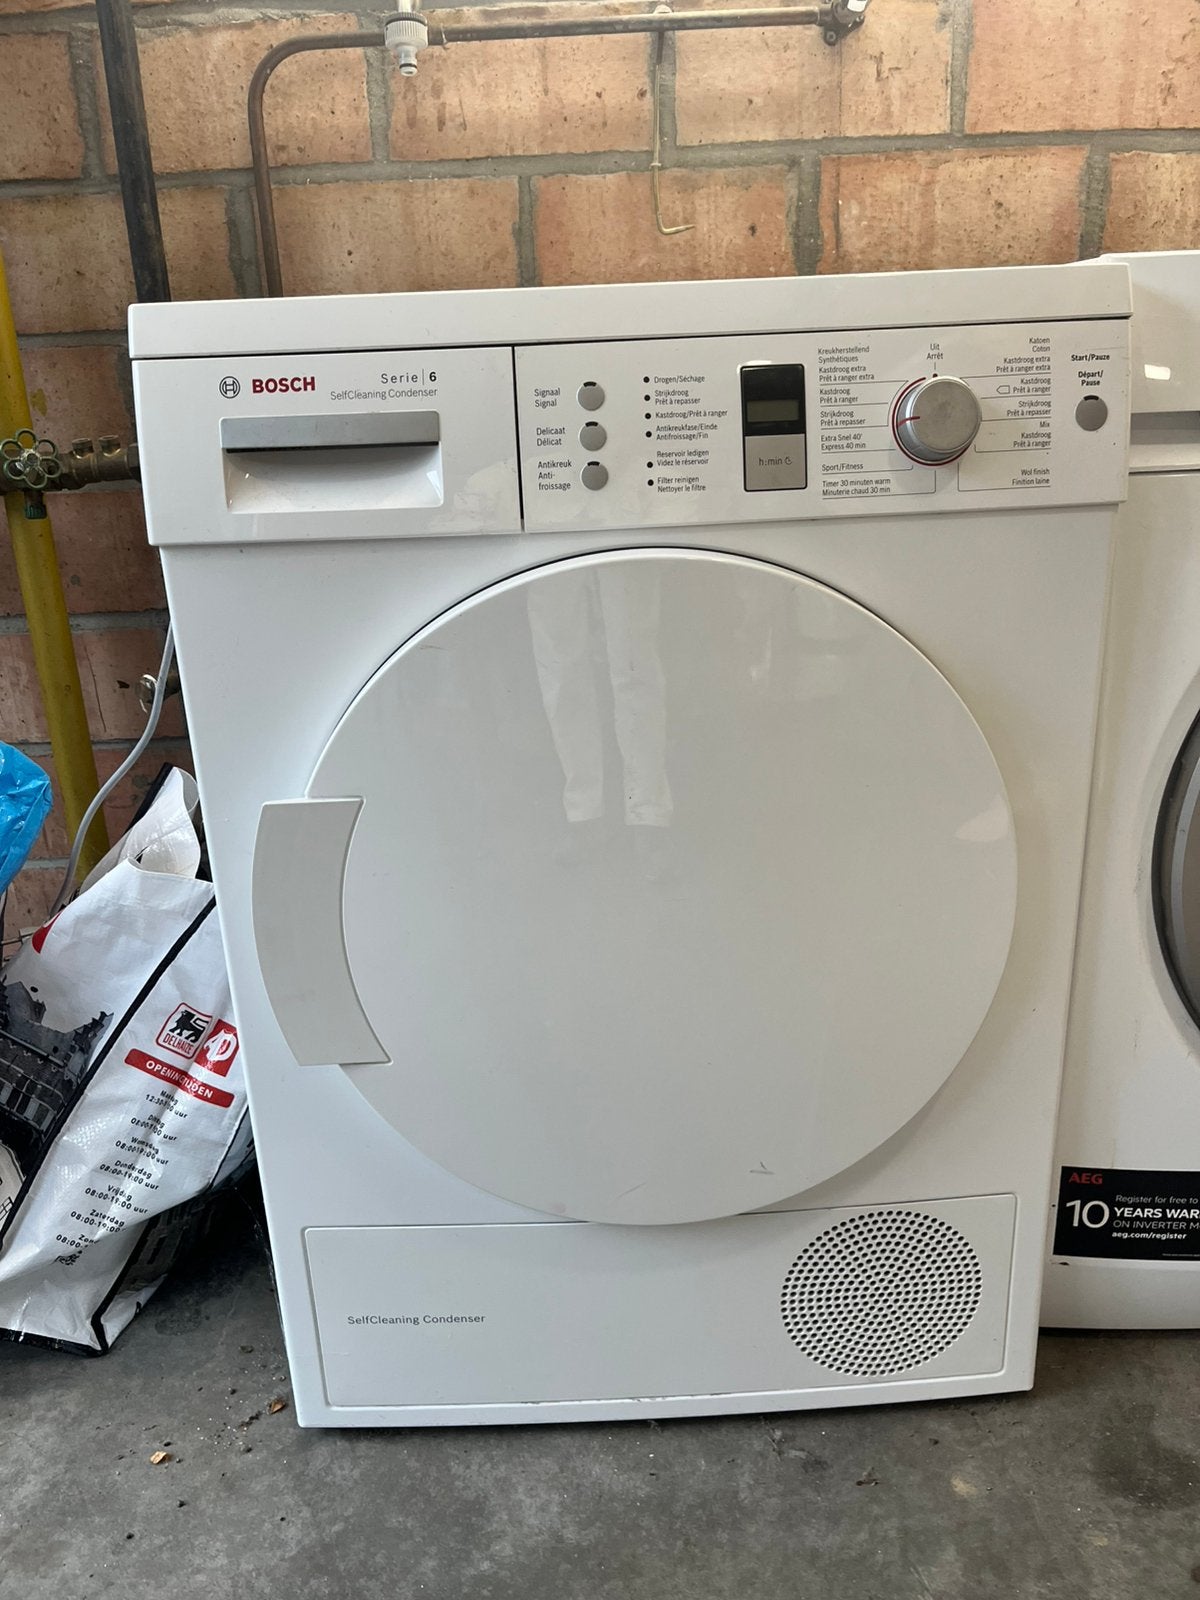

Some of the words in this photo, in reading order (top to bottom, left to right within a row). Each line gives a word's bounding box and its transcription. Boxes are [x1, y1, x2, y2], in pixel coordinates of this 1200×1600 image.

[818, 346, 870, 355] Kreukherstellend
[818, 356, 858, 364] Synthétiques
[927, 352, 943, 360] Arrêt
[1071, 354, 1110, 362] Start/Pauze
[819, 366, 850, 374] Kastdroog
[1078, 370, 1104, 378] Départ/
[381, 373, 418, 384] Serie
[429, 371, 437, 382] 6
[654, 376, 705, 384] Drogen/Séchage
[1020, 377, 1051, 385] Kastdroog
[252, 376, 316, 393] BOSCH
[330, 389, 387, 400] SelfCleaning
[388, 388, 438, 398] Condenser
[534, 388, 560, 398] Signaal
[535, 399, 557, 409] Signal
[1018, 400, 1051, 408] Strijkdroog
[656, 410, 702, 419] Kastdroog/Prêt
[708, 410, 727, 418] ranger
[820, 410, 854, 418] Strijkdroog
[536, 427, 565, 436] Delicaat
[656, 423, 718, 432] Antikreukfase/Einde
[656, 432, 708, 441] Antifroissage/Fin
[1021, 431, 1051, 439] Kastdroog
[537, 438, 562, 446] Délicat
[1032, 440, 1051, 448] ranger
[821, 443, 844, 451] Express
[657, 450, 686, 458] Reservoir
[687, 450, 709, 458] ledigen
[538, 460, 572, 468] Antikreuk
[682, 458, 709, 466] réservoir
[758, 457, 782, 466] h:min
[822, 463, 864, 472] Sport/Fitness
[538, 472, 555, 480] Anti-
[675, 476, 699, 484] reinigen
[539, 482, 571, 491] froissage
[851, 487, 869, 495] chaud
[162, 1033, 194, 1054] DELHAIZE
[163, 1133, 178, 1141] uur
[1069, 1172, 1103, 1184] AEG
[145, 1182, 159, 1190] uur
[85, 1187, 132, 1209] 08:00-19:00
[134, 1206, 148, 1214] uur
[1116, 1195, 1152, 1204] Register
[1155, 1196, 1166, 1204] for
[1169, 1196, 1187, 1204] free
[1066, 1200, 1110, 1228] 10
[1114, 1207, 1162, 1218] YEARS
[1166, 1209, 1200, 1219] WAR
[71, 1211, 121, 1232] 08:00-19:00
[90, 1209, 125, 1227] Zaterdag
[1113, 1220, 1130, 1228] ON
[1133, 1220, 1187, 1230] INVERTER
[1112, 1232, 1187, 1240] aeg.com/register
[348, 1315, 419, 1325] SelfCleaning
[423, 1314, 486, 1323] Condenser
